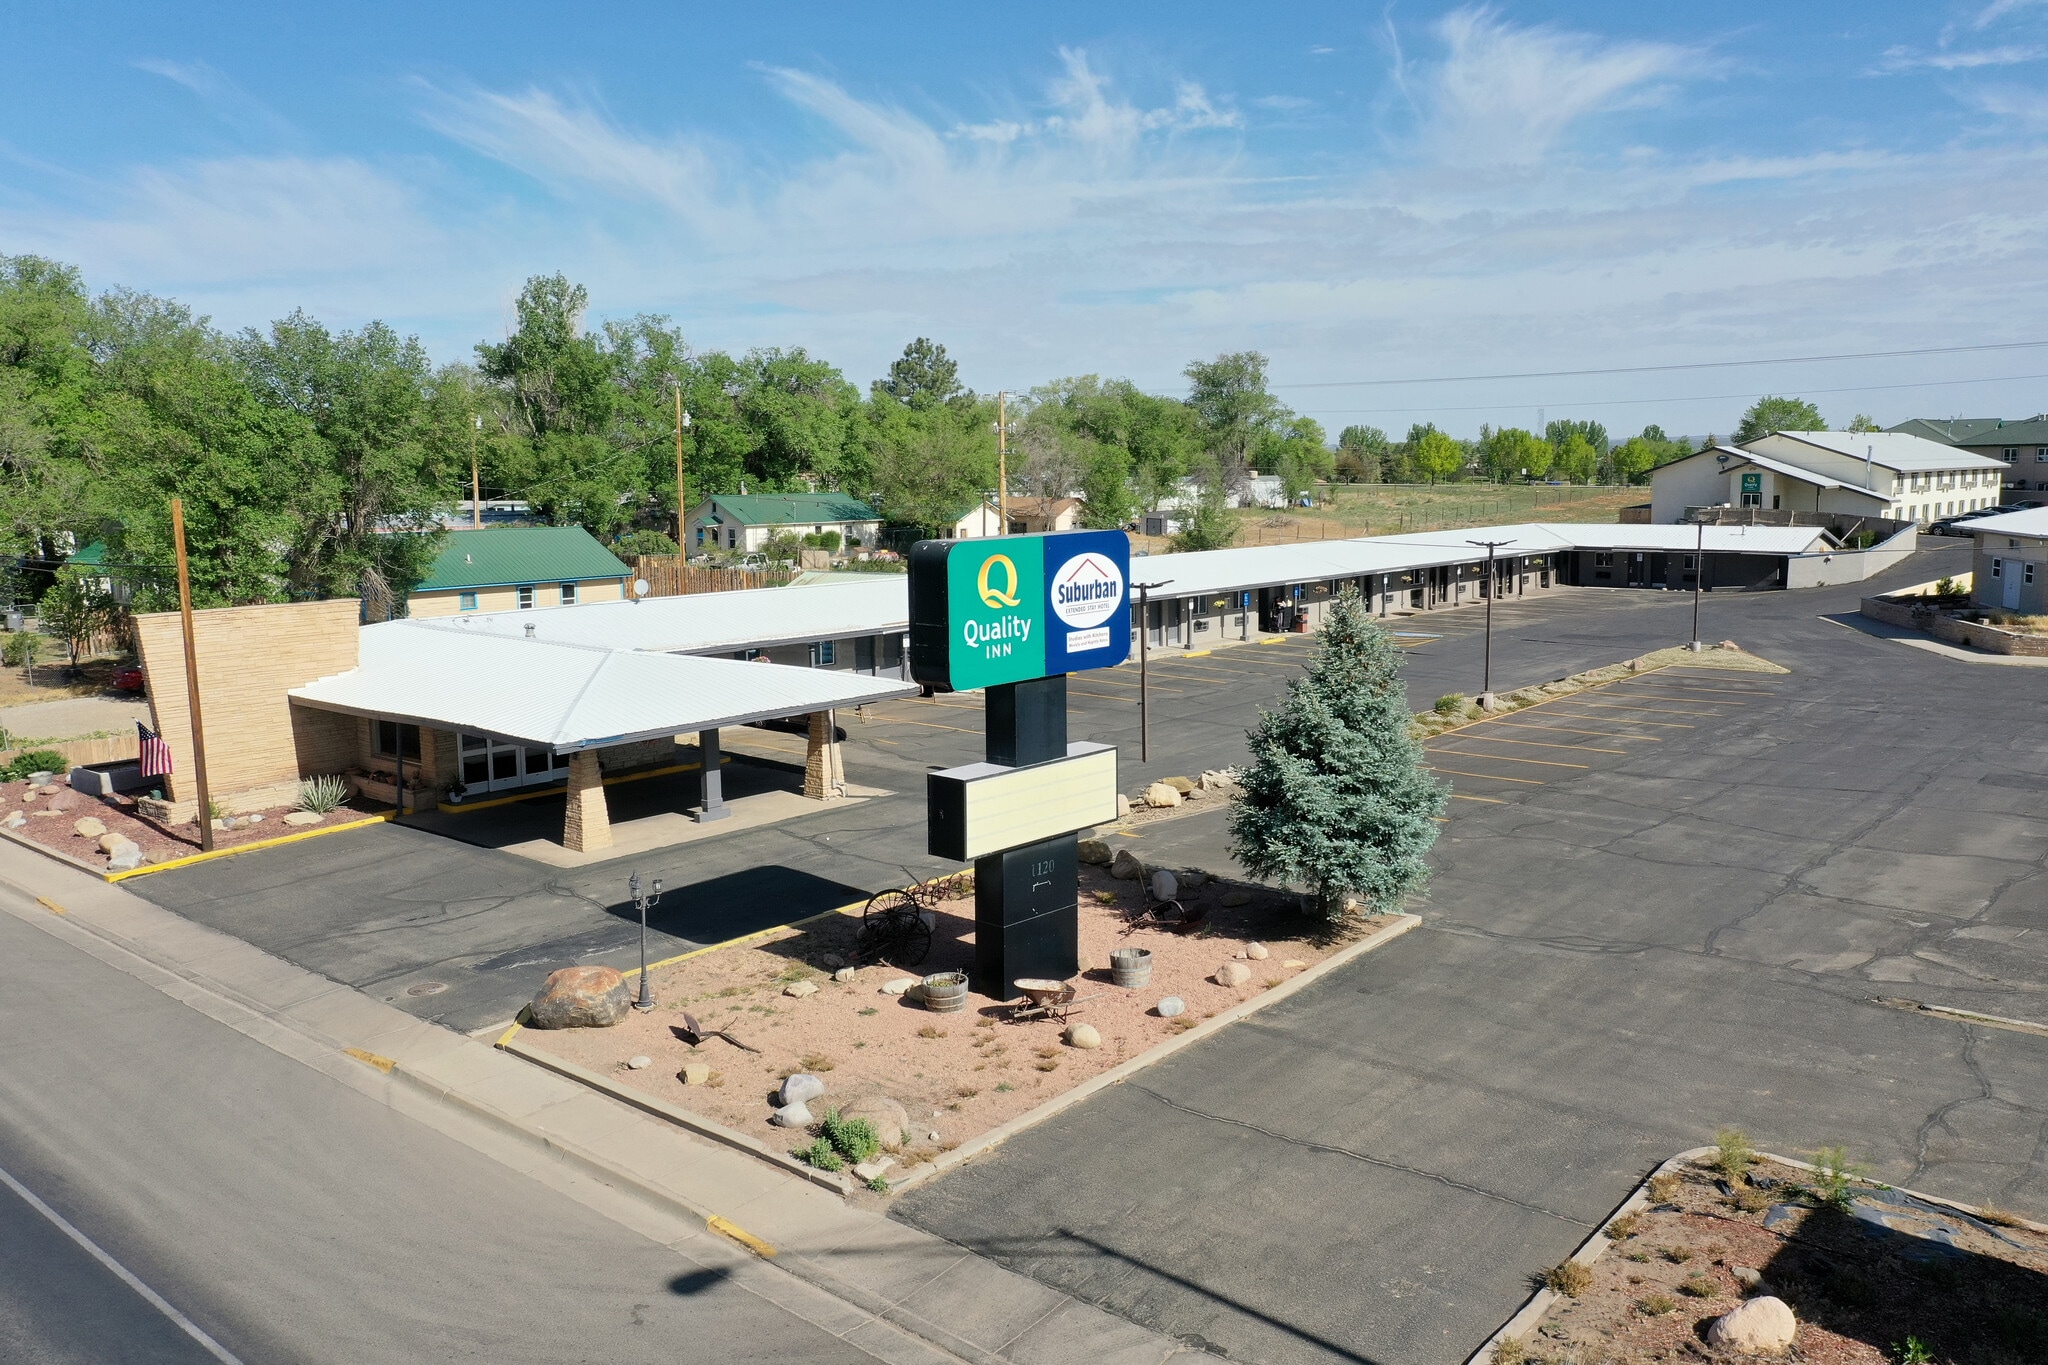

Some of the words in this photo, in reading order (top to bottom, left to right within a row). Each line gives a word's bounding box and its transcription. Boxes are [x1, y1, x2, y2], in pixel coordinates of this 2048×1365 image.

[977, 554, 1021, 608] Q
[1058, 579, 1117, 604] Suburban
[1066, 606, 1086, 614] EXTENDED
[963, 615, 1032, 648] Quality
[985, 642, 1012, 659] INN
[1031, 859, 1055, 877] 1120
